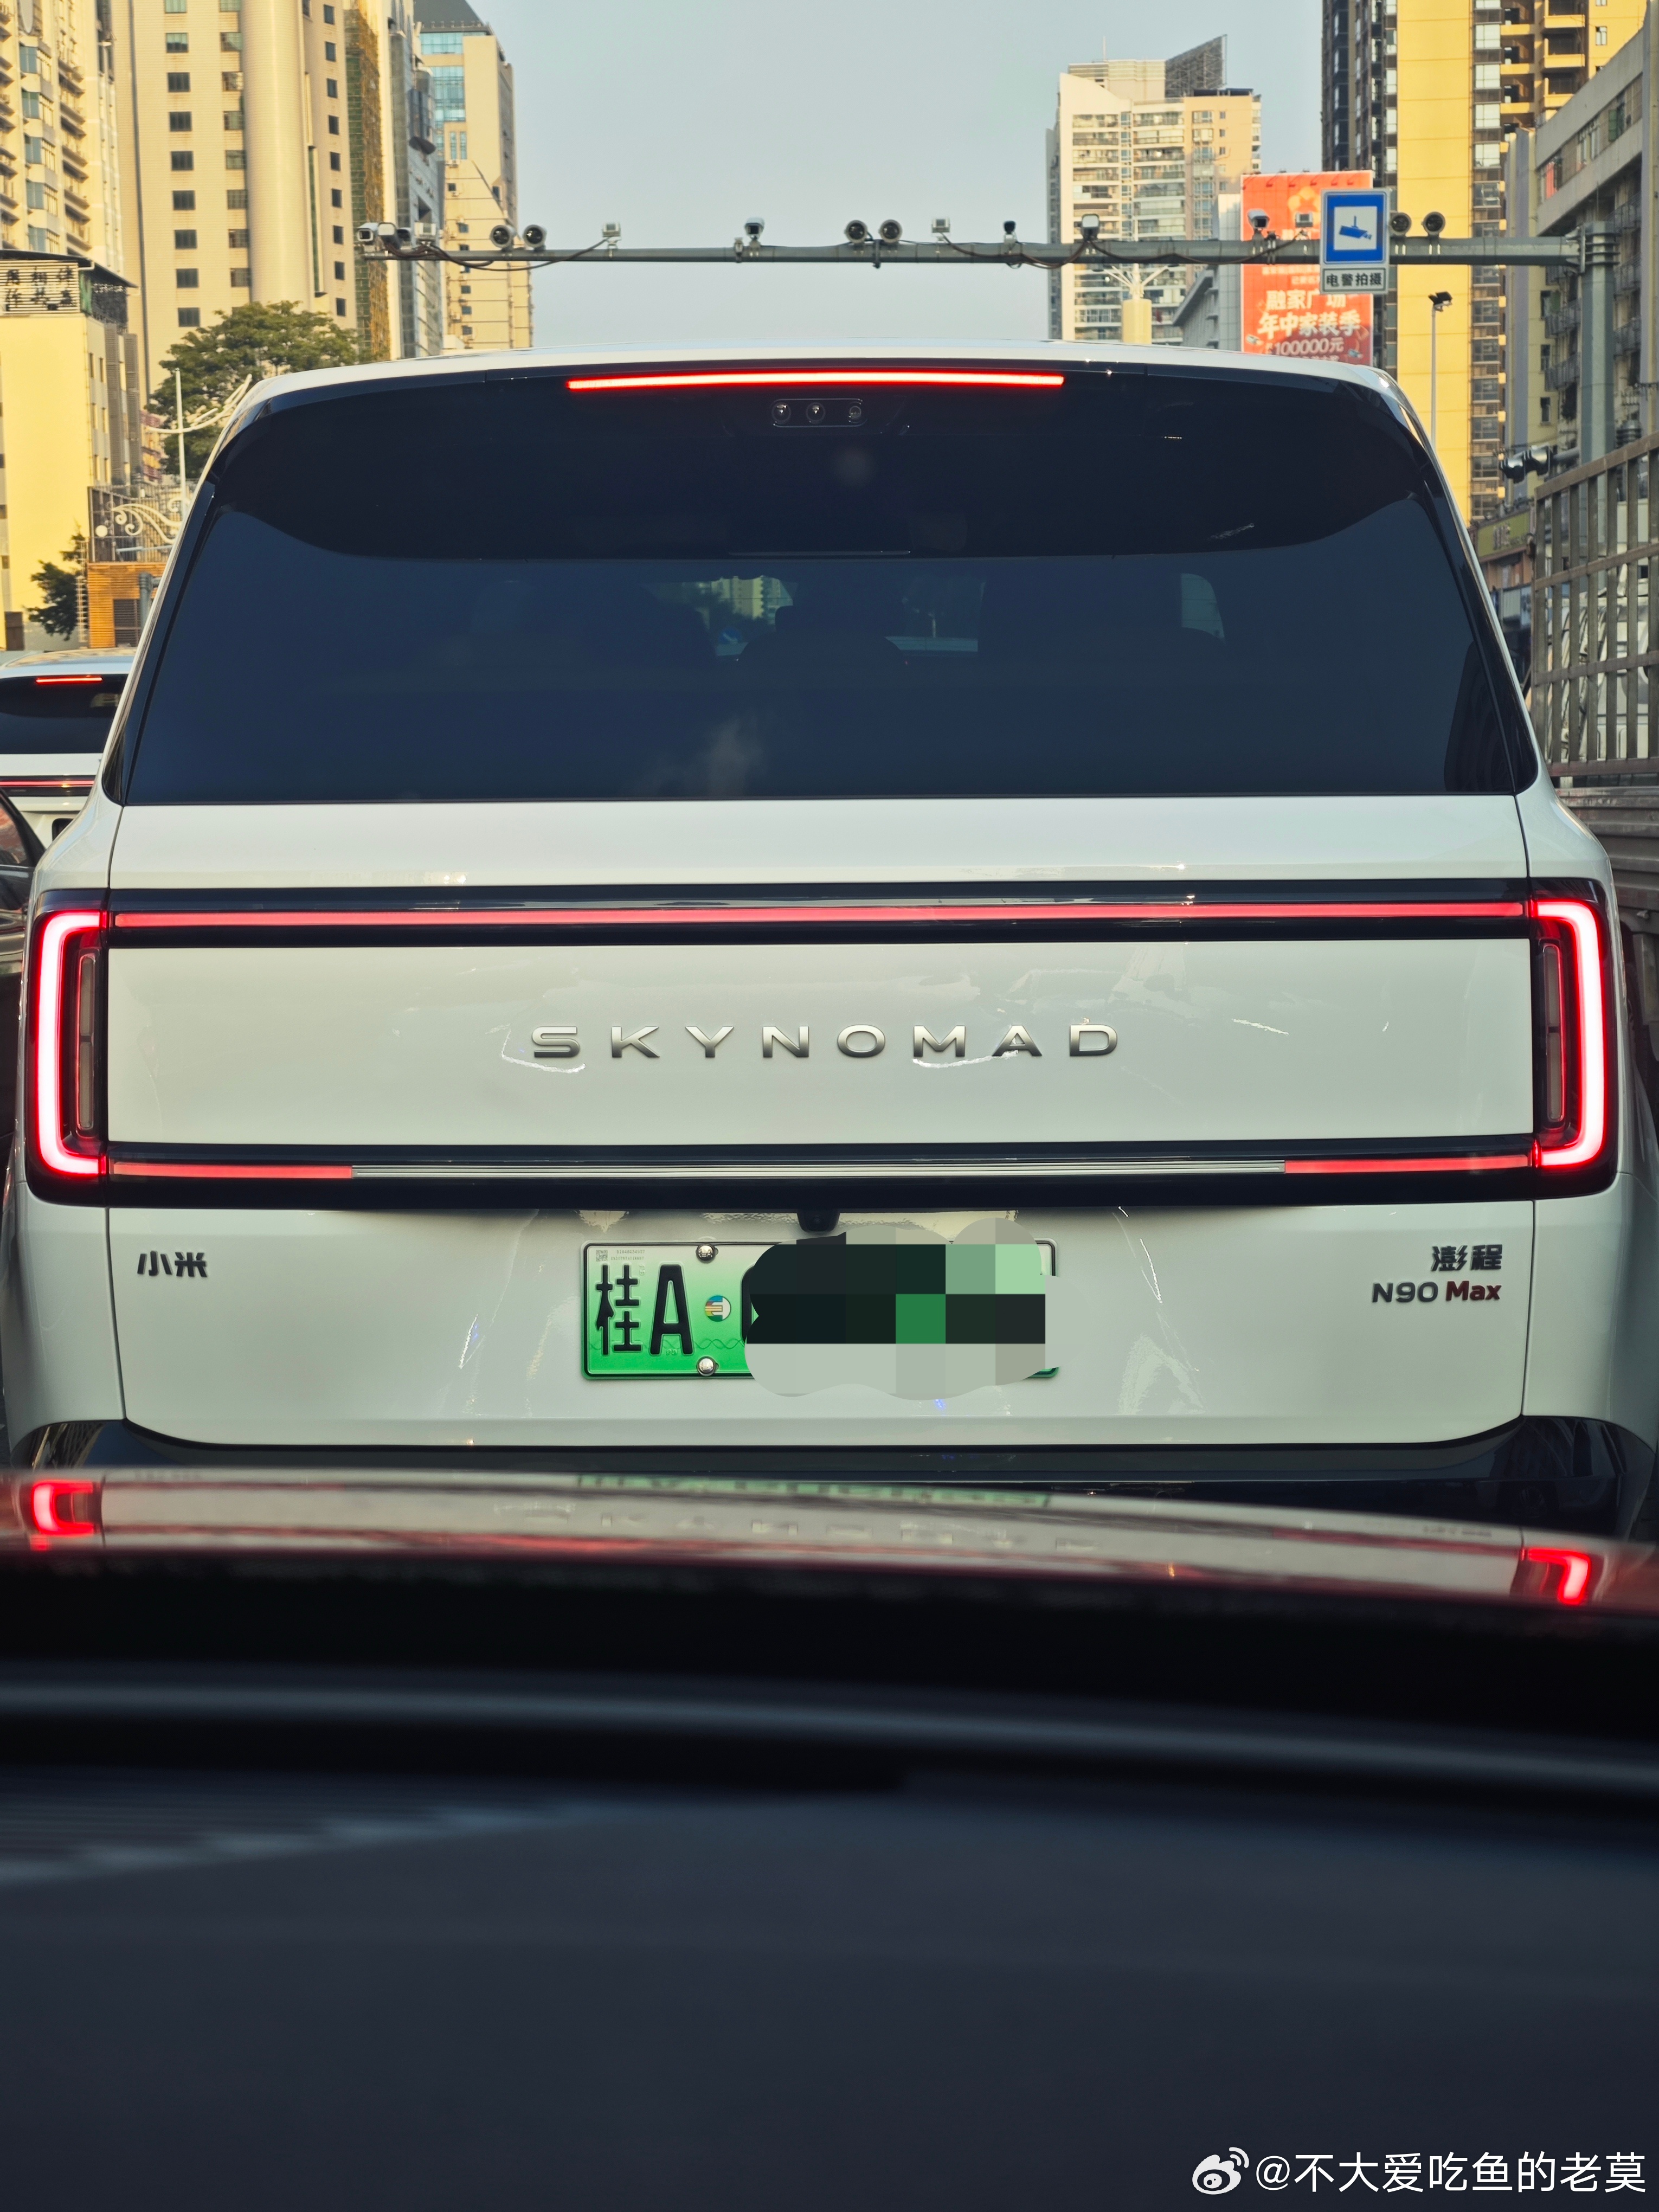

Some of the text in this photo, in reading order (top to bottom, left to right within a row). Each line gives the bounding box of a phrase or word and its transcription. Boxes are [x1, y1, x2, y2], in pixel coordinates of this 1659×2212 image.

[1326, 273, 1382, 287] 电警拍摄
[1257, 309, 1361, 340] 年中家装季
[532, 1025, 1118, 1058] SKYNOMAD
[137, 1251, 208, 1277] 小米
[1430, 1244, 1502, 1271] 澎程
[1372, 1281, 1502, 1302] N90 Max
